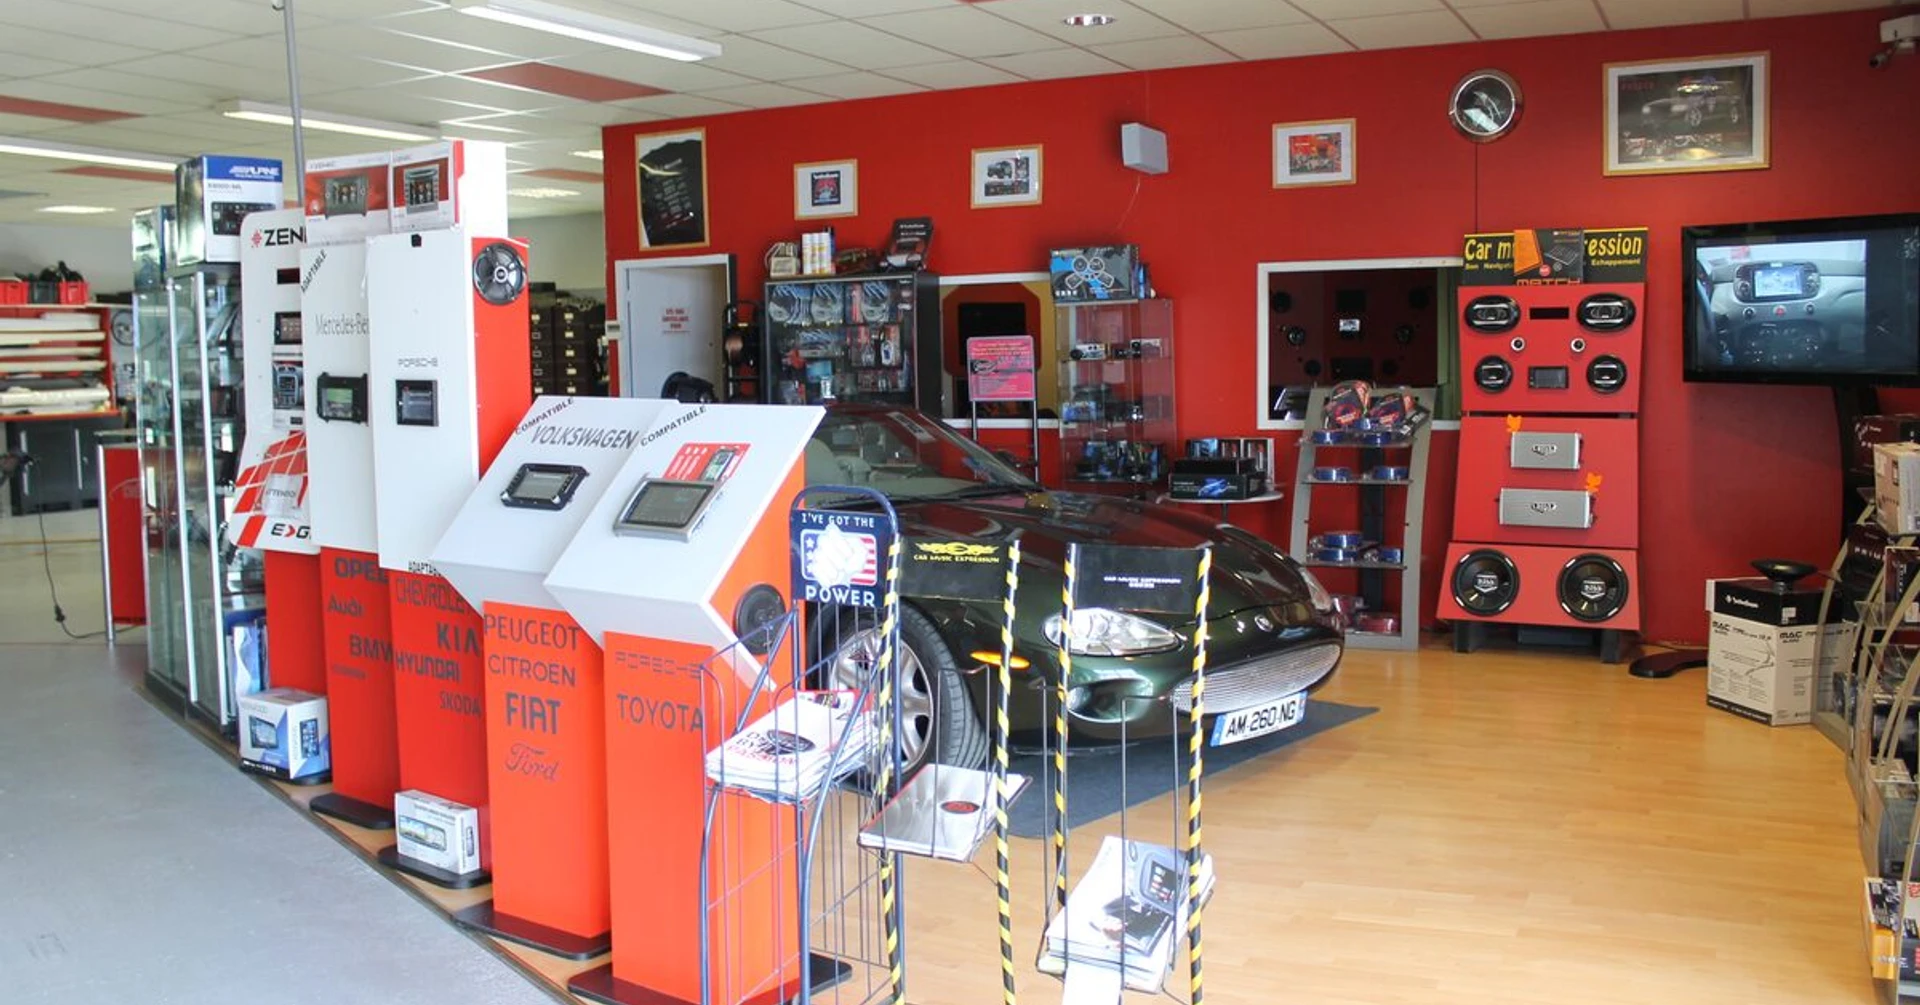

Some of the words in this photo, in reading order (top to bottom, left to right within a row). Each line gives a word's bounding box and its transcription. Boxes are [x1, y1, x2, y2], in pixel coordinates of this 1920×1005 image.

[264, 226, 307, 246] ZEN
[1465, 239, 1493, 260] Car
[300, 249, 327, 294] ADAPTABLE
[398, 357, 439, 368] PORSCHE
[515, 397, 574, 435] COMPATIBLE
[640, 405, 707, 447] COMPATIBLE
[530, 425, 640, 450] VOLKSWAGEN
[802, 513, 825, 525] I'VE
[829, 516, 850, 527] GOT
[853, 517, 875, 529] THE
[334, 557, 388, 585] OPEL
[328, 593, 365, 617] Audi
[805, 585, 876, 607] POWER
[436, 622, 481, 657] KIA
[484, 613, 580, 650] PEUGEOT
[350, 633, 393, 664] BMW
[395, 652, 461, 683] HYUNDAI
[615, 651, 701, 680] PORSCHE
[440, 690, 482, 718] SKODA
[505, 691, 561, 735] FIAT
[616, 693, 704, 733] TOYOTA
[505, 743, 560, 781] Ford
